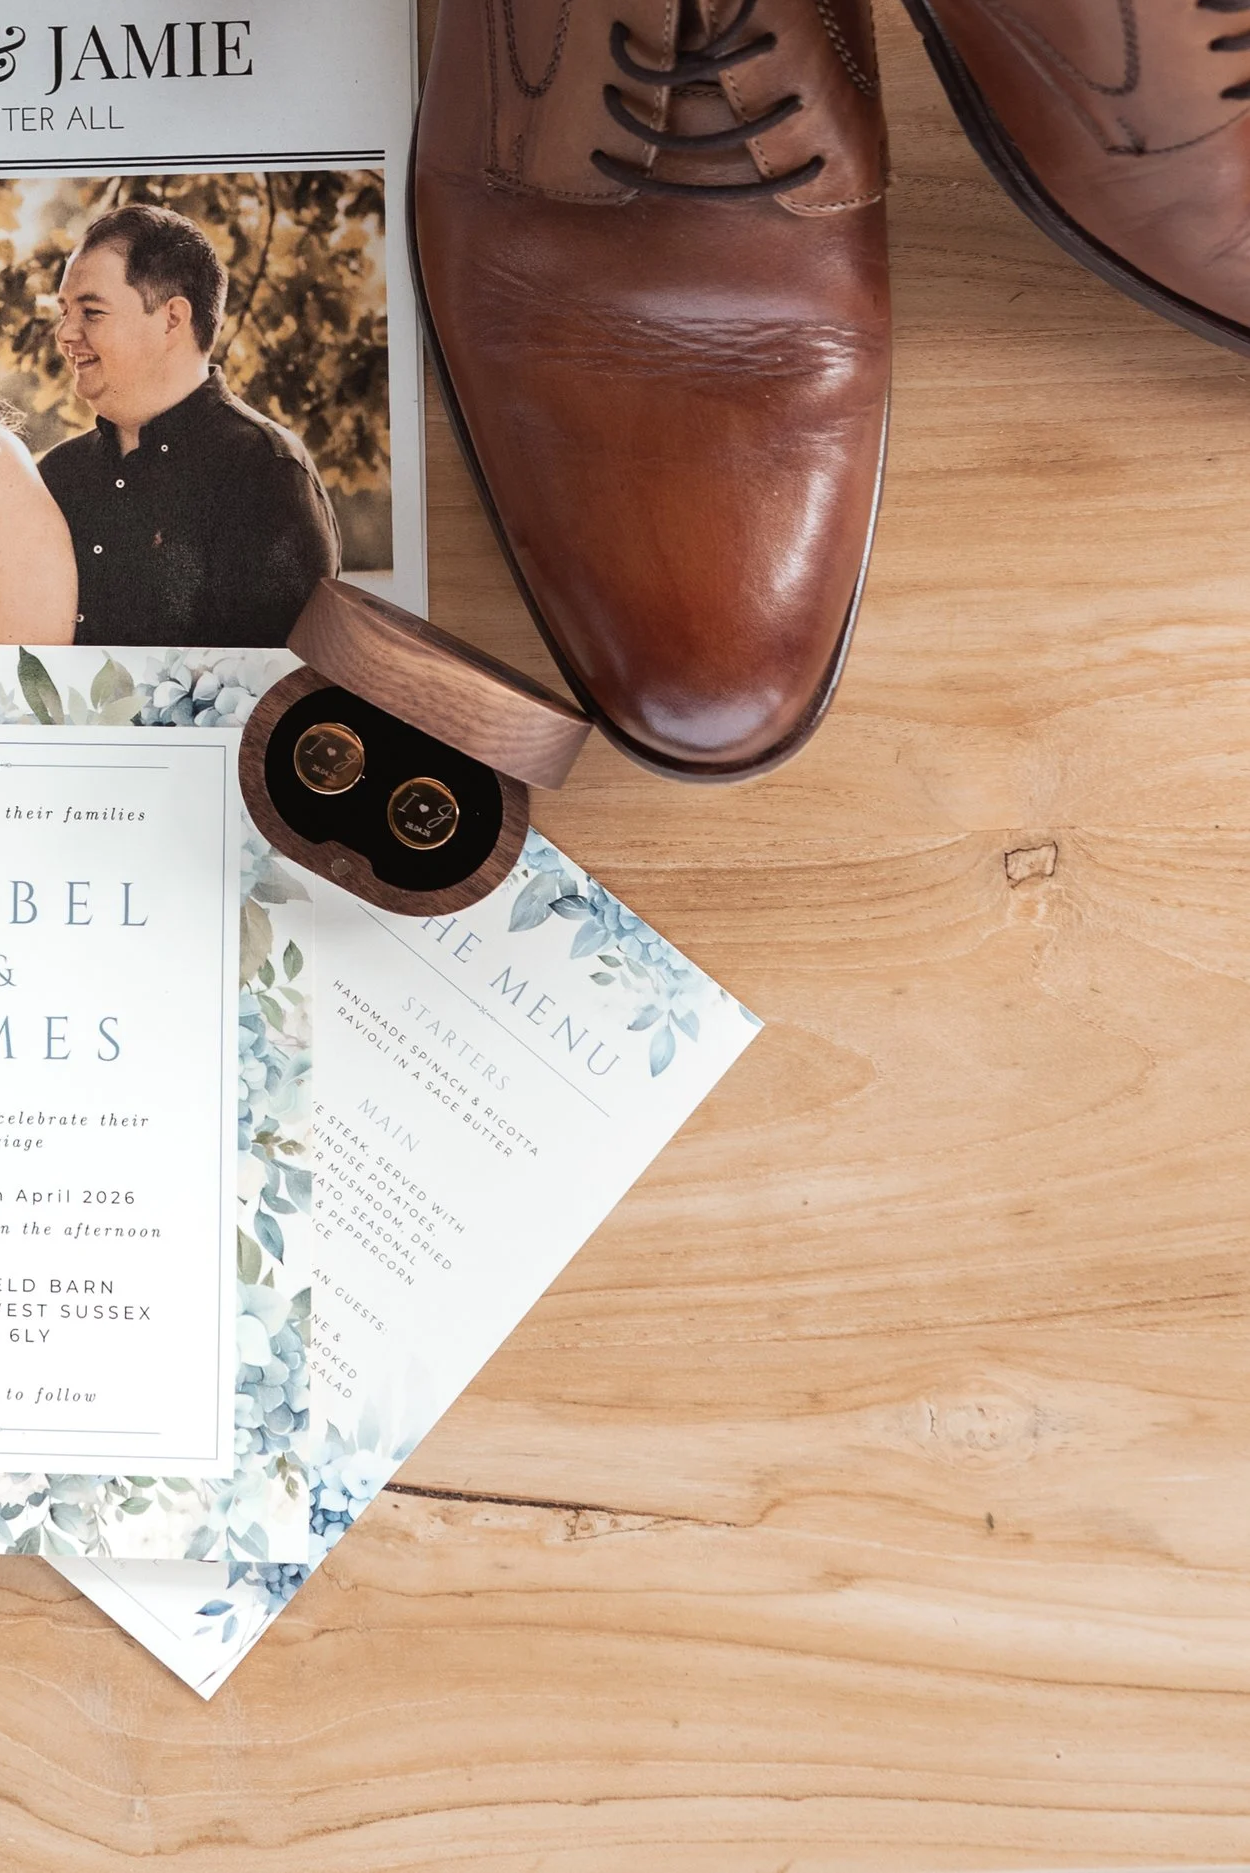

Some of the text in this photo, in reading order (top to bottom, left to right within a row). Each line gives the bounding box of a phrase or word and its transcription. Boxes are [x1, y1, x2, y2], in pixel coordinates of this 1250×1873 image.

[45, 20, 252, 95] JAMIE
[67, 106, 124, 130] ALL
[5, 805, 54, 820] their
[62, 806, 146, 824] families
[421, 916, 621, 1076] HE MENU
[400, 995, 510, 1091] STARTERS
[332, 978, 538, 1157] HANDMADE SPINACH & RICOTTA
[335, 1005, 513, 1158] RAVIOLI IN A SAGE BUTTER
[100, 1112, 149, 1127] their
[356, 1097, 421, 1153] MAIN
[311, 1122, 436, 1237] HINOISE POTATOES,
[326, 1114, 465, 1234] STEAK, SERVED WITH
[15, 1188, 70, 1206] April
[82, 1190, 135, 1205] 2026
[326, 1161, 452, 1270] MUSHROOM, DRIED
[22, 1221, 51, 1236] the
[63, 1222, 161, 1240] afternoon
[314, 1198, 324, 1209] &
[326, 1208, 415, 1286] PEPPERCORN
[349, 1204, 416, 1266] SEASONAL
[50, 1279, 113, 1294] BARN
[60, 1304, 150, 1321] SUSSEX
[9, 1328, 50, 1343] 6LY
[331, 1331, 341, 1343] &
[310, 1337, 358, 1380] MOKED
[310, 1360, 353, 1399] SALAD
[6, 1388, 24, 1401] to
[34, 1386, 97, 1405] follow
